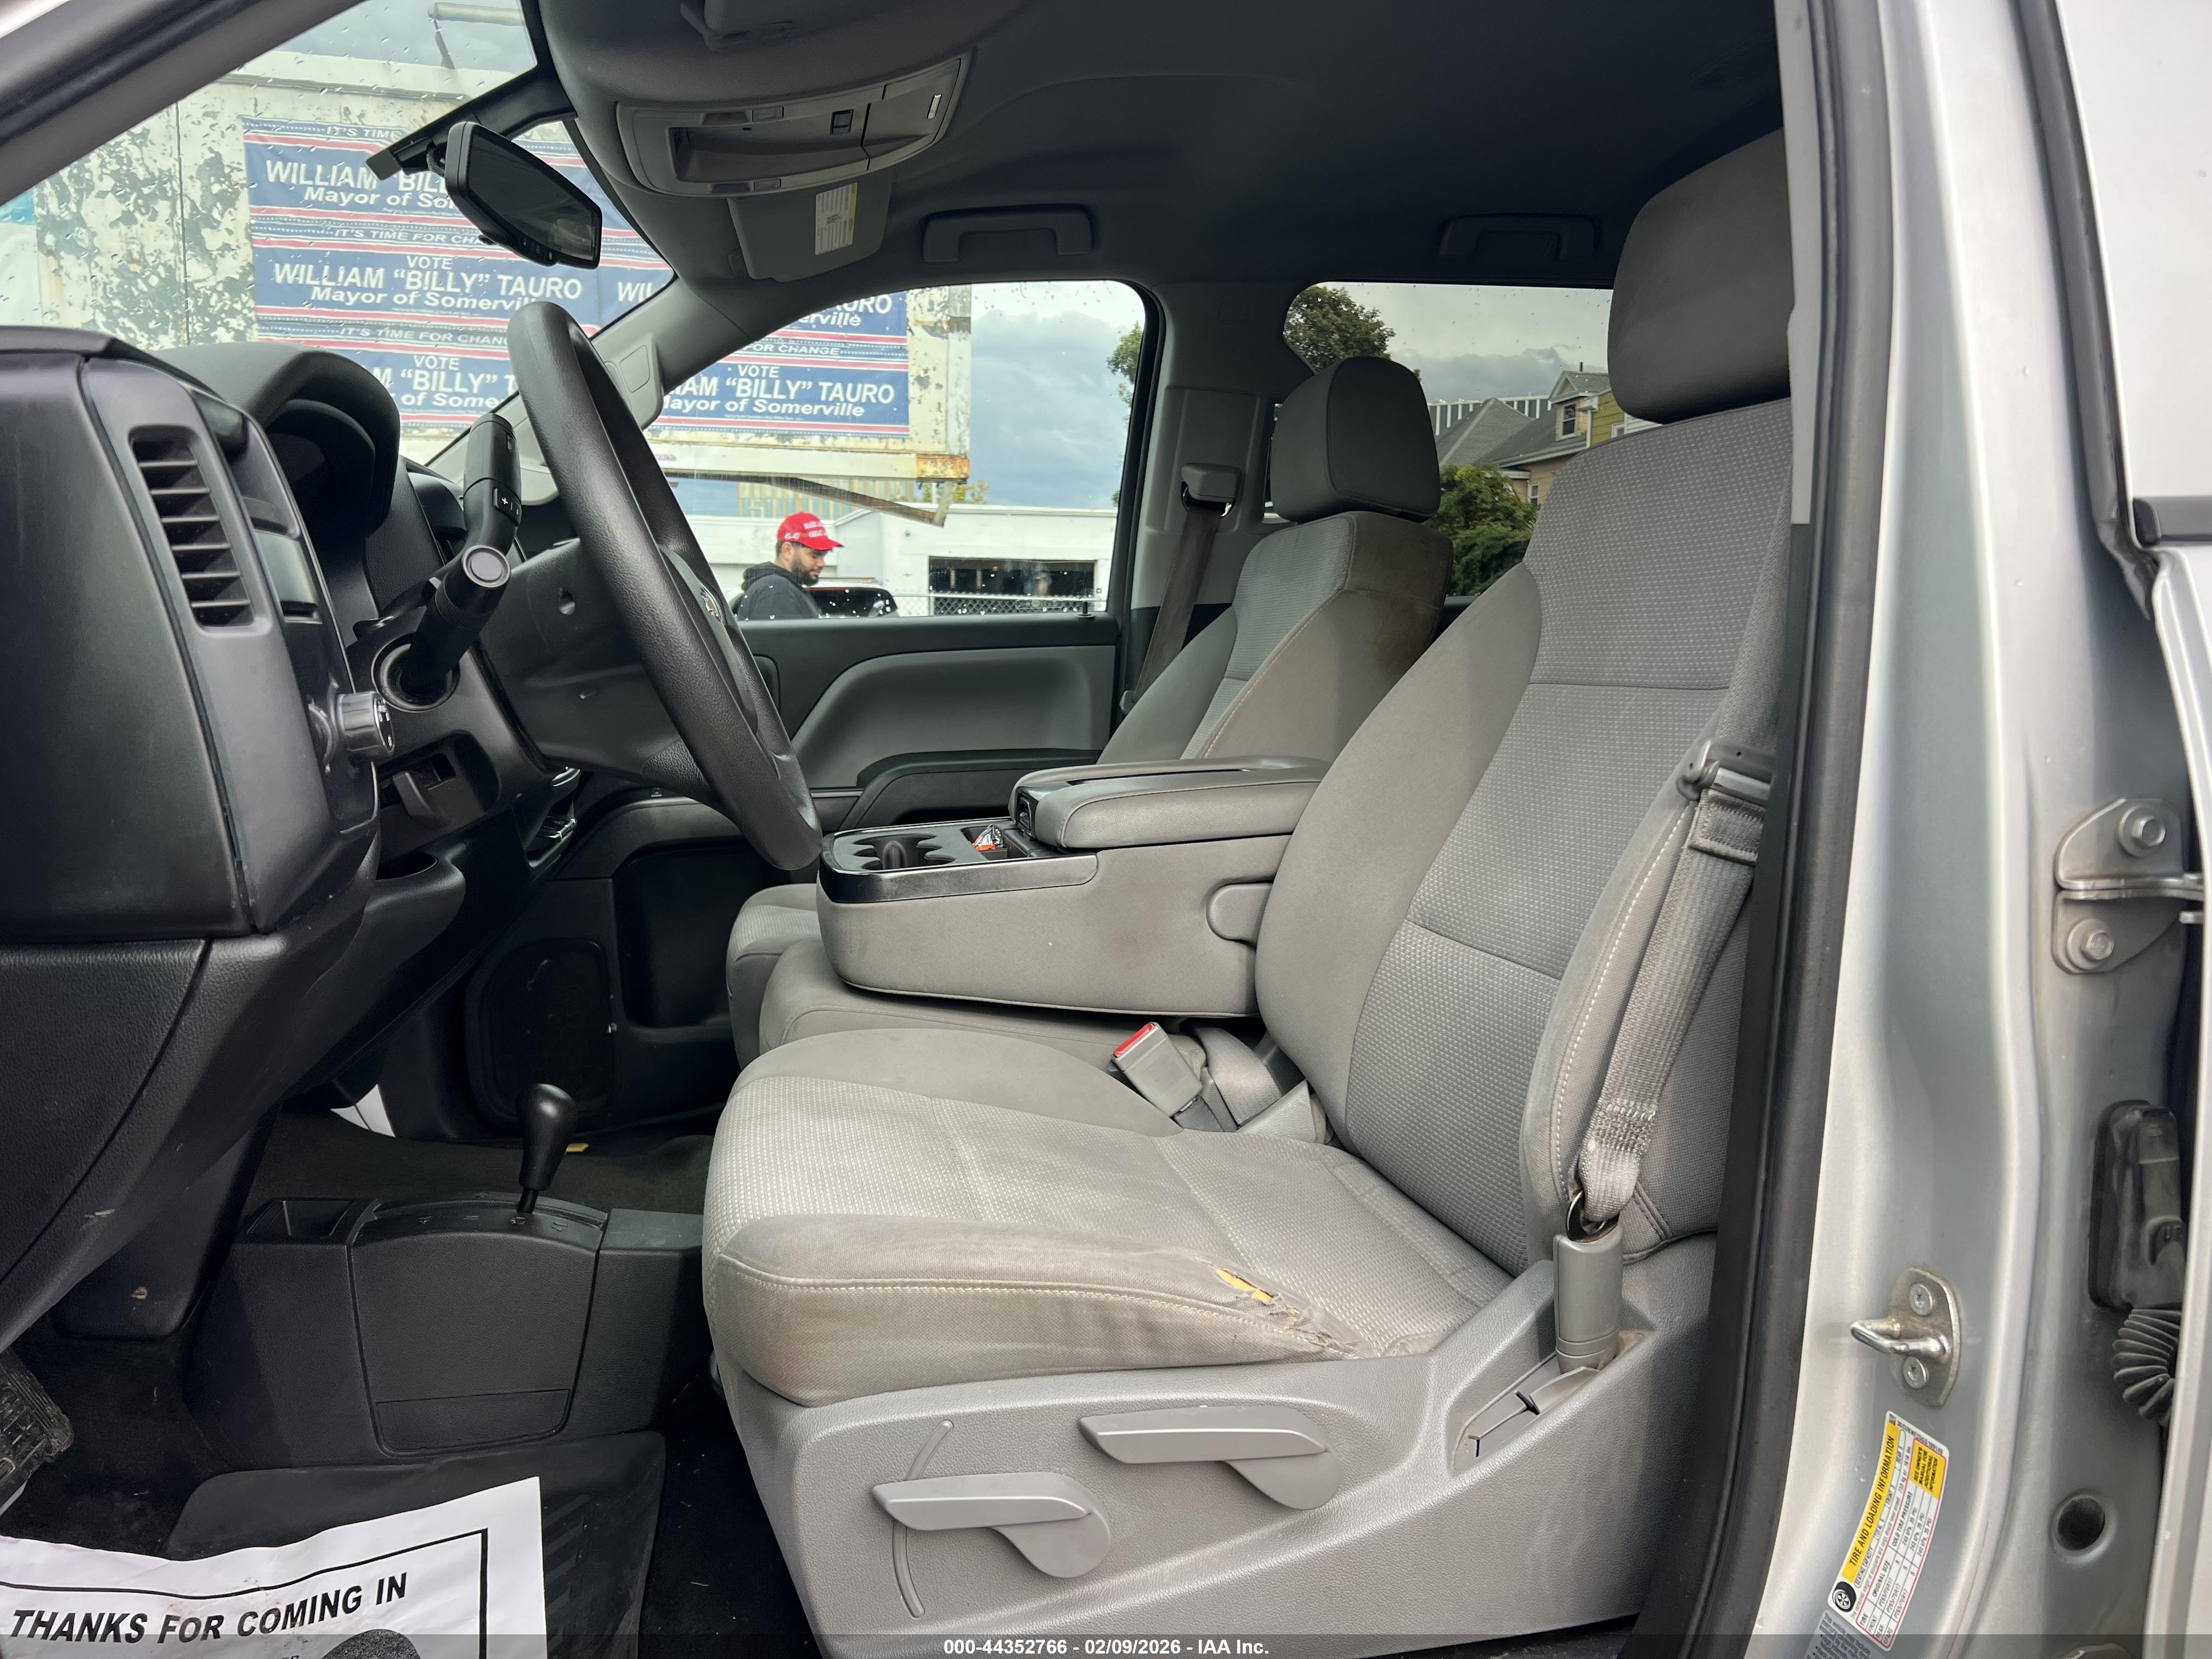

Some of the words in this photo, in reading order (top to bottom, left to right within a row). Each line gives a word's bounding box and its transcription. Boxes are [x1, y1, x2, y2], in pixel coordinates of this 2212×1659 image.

[326, 126, 357, 137] IT'S
[266, 160, 379, 189] WILLIAM
[304, 187, 380, 206] Mayor
[386, 192, 413, 206] of
[335, 229, 364, 238] IT'S
[370, 230, 408, 241] TIME
[412, 233, 447, 242] FOR
[406, 256, 453, 269] VOTE
[275, 263, 385, 289] WILLIAM
[497, 274, 582, 300] TAURO
[311, 286, 387, 306] Mayor
[393, 291, 421, 305] of
[836, 295, 892, 314] URO
[799, 312, 862, 326] erville
[340, 328, 371, 337] IT'S
[377, 329, 413, 339] TIME
[419, 331, 453, 342] FOR
[458, 334, 507, 345] CHAN
[778, 345, 840, 356] CHANGE
[413, 355, 460, 370] VOTE
[738, 365, 780, 377] VOTE
[401, 392, 427, 406] of
[819, 382, 895, 404] TAURO
[725, 399, 749, 411] of
[753, 399, 865, 416] Somerville
[1849, 1547, 1861, 1566] TIRE
[1857, 1528, 1869, 1547] AND
[1865, 1493, 1882, 1528] LOADING
[1877, 1435, 1895, 1492] INFORMATION
[1854, 1566, 1865, 1585] SEATING
[1862, 1547, 1874, 1567] CAPACITY
[1859, 1613, 1868, 1626] TIRE
[1872, 1572, 1884, 1597] ORIGINAL
[1892, 1532, 1900, 1547] COLD
[1901, 1491, 1912, 1519] PRESSURE
[10, 1610, 148, 1643] THANKS
[157, 1614, 224, 1643] FOR
[237, 1585, 363, 1637] COMING
[375, 1572, 407, 1606] IN
[1867, 1614, 1877, 1632] FRONT
[1876, 1624, 1884, 1638] REAR
[1883, 1627, 1893, 1644] SPARE
